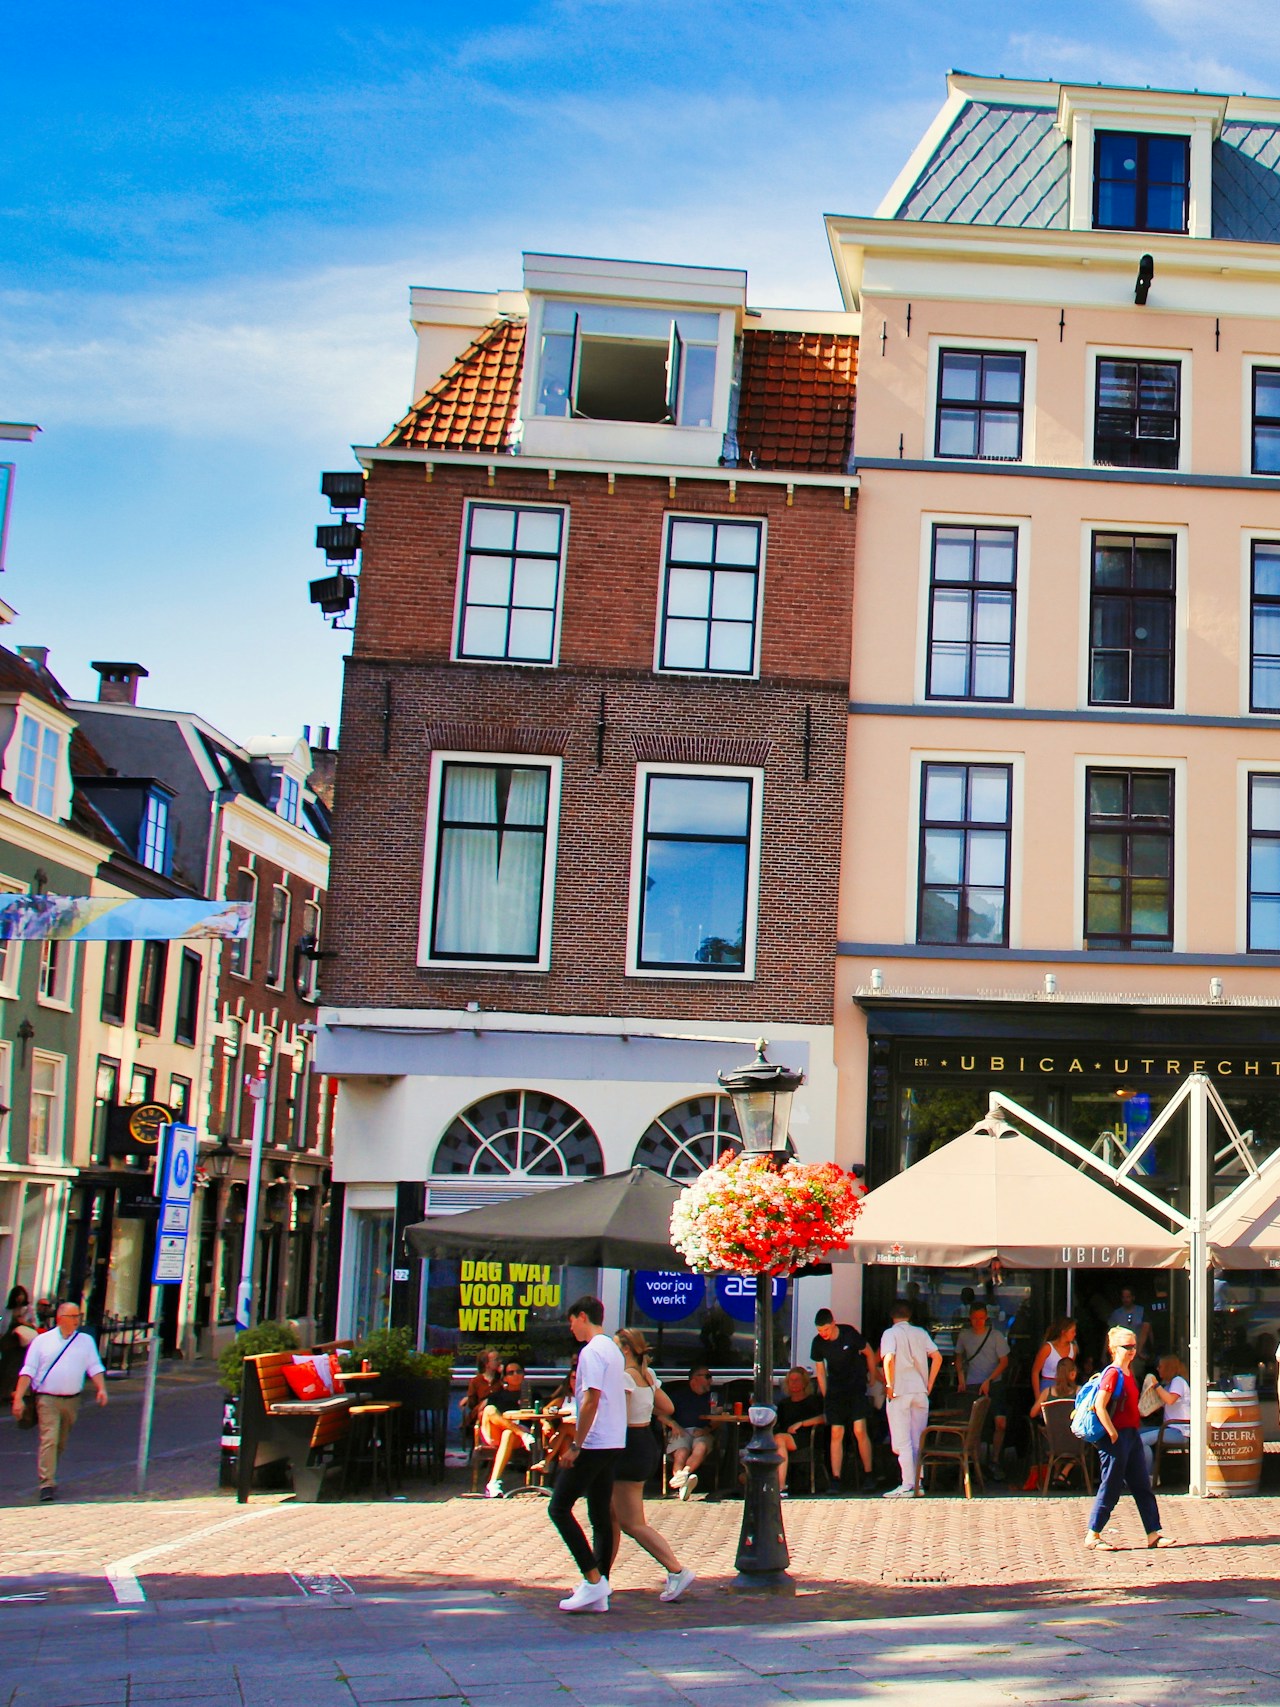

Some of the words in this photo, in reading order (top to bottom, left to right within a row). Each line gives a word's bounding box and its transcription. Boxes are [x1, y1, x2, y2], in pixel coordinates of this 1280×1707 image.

[914, 1058, 930, 1067] EST.
[960, 1056, 1084, 1073] UBICA
[876, 1254, 916, 1264] Heineken
[1061, 1247, 1125, 1264] UBICA
[461, 1260, 502, 1282] DAG
[509, 1262, 551, 1283] WAT
[646, 1281, 673, 1291] voor
[674, 1280, 693, 1292] jou
[460, 1283, 514, 1307] VOOR
[520, 1284, 561, 1307] JOU
[652, 1294, 686, 1305] werkt
[458, 1308, 529, 1332] WERKT
[1221, 1431, 1240, 1441] DEL
[1222, 1446, 1254, 1456] MEZZO
